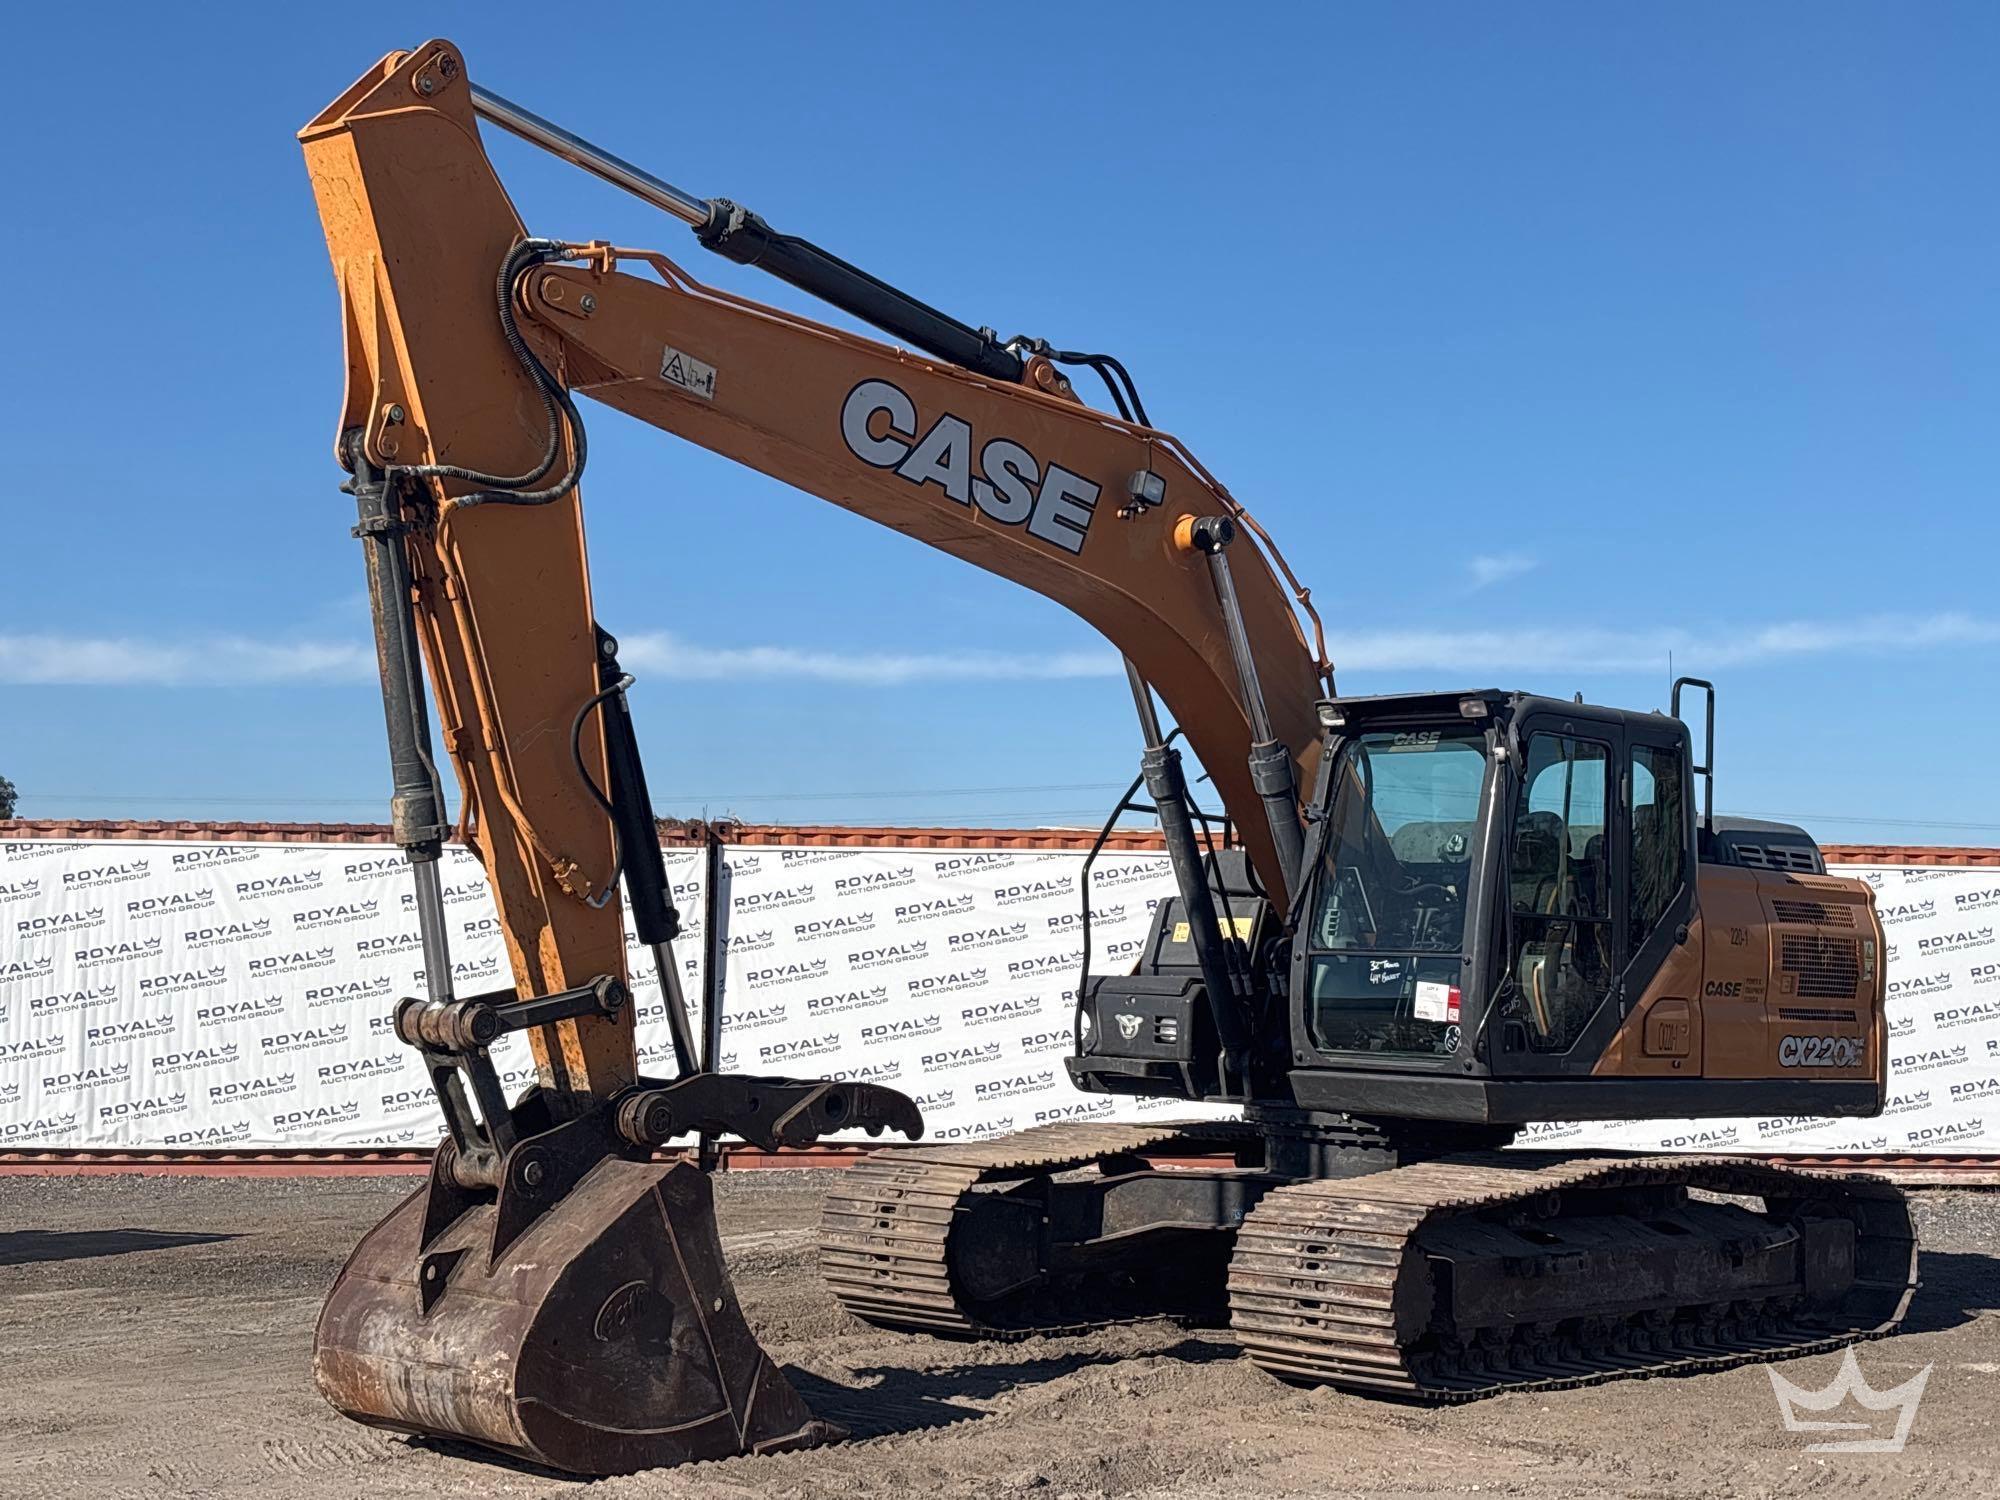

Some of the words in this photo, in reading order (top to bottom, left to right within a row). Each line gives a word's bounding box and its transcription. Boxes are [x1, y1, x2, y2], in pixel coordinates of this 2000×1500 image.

[840, 377, 1102, 555] CASE
[1393, 731, 1441, 745] CASE
[172, 846, 239, 865] ROYAL
[175, 860, 221, 873] AUCTION
[223, 854, 259, 864] GROUP
[784, 857, 826, 868] AUCTION
[935, 854, 996, 871] ROYAL
[63, 865, 131, 883] ROYAL
[938, 867, 979, 878] AUCTION
[981, 861, 1015, 871] GROUP
[1094, 863, 1154, 881] ROYAL
[1905, 872, 1946, 883] AUCTION
[65, 879, 112, 891] AUCTION
[114, 872, 151, 883] GROUP
[237, 875, 303, 893] ROYAL
[835, 872, 897, 889] ROYAL
[838, 885, 880, 896] AUCTION
[882, 879, 915, 889] GROUP
[1096, 877, 1137, 888] AUCTION
[1140, 870, 1172, 881] GROUP
[4, 891, 40, 902] GROUP
[239, 889, 285, 901] AUCTION
[287, 882, 323, 893] GROUP
[734, 890, 797, 907] ROYAL
[994, 881, 1056, 899] ROYAL
[997, 895, 1039, 906] AUCTION
[1041, 888, 1075, 898] GROUP
[127, 893, 195, 912] ROYAL
[130, 907, 176, 920] AUCTION
[179, 901, 215, 912] GROUP
[737, 903, 779, 914] AUCTION
[782, 897, 815, 907] GROUP
[895, 899, 957, 916] ROYAL
[1958, 900, 1998, 912] AUCTION
[18, 912, 86, 931] ROYAL
[294, 904, 360, 923] ROYAL
[297, 919, 342, 931] AUCTION
[344, 912, 380, 923] GROUP
[898, 912, 940, 924] AUCTION
[942, 906, 975, 916] GROUP
[1905, 911, 1937, 922] GROUP
[20, 926, 67, 939] AUCTION
[69, 920, 105, 930] GROUP
[185, 923, 252, 942] ROYAL
[795, 917, 857, 934] ROYAL
[797, 930, 840, 942] AUCTION
[842, 924, 875, 934] GROUP
[187, 937, 233, 950] AUCTION
[236, 931, 272, 941] GROUP
[948, 927, 1010, 945] ROYAL
[951, 941, 993, 952] AUCTION
[995, 935, 1029, 945] GROUP
[1918, 931, 1978, 949] ROYAL
[76, 942, 143, 961] ROYAL
[848, 945, 910, 963] ROYAL
[1921, 945, 1962, 956] AUCTION
[1964, 939, 1995, 948] GROUP
[78, 956, 124, 969] AUCTION
[127, 950, 163, 960] GROUP
[249, 951, 316, 970] ROYAL
[252, 966, 297, 978] AUCTION
[300, 959, 336, 970] GROUP
[851, 959, 893, 970] AUCTION
[895, 953, 929, 963] GROUP
[1007, 954, 1070, 972] ROYAL
[17, 969, 53, 980] GROUP
[140, 971, 208, 989] ROYAL
[747, 964, 810, 981] ROYAL
[749, 977, 792, 989] AUCTION
[794, 971, 828, 981] GROUP
[908, 972, 970, 990] ROYAL
[1010, 968, 1053, 980] AUCTION
[142, 985, 189, 997] AUCTION
[191, 978, 227, 989] GROUP
[306, 981, 372, 1000] ROYAL
[911, 986, 953, 998] AUCTION
[955, 980, 989, 990] GROUP
[1705, 980, 1742, 997] CASE
[1919, 985, 1952, 996] GROUP
[31, 990, 98, 1009] ROYAL
[309, 995, 354, 1007] AUCTION
[356, 989, 392, 999] GROUP
[807, 991, 870, 1009] ROYAL
[810, 1005, 853, 1016] AUCTION
[855, 998, 888, 1008] GROUP
[33, 1004, 79, 1017] AUCTION
[82, 998, 118, 1008] GROUP
[197, 1000, 265, 1019] ROYAL
[961, 1000, 1024, 1019] ROYAL
[1934, 1004, 1993, 1022] ROYAL
[200, 1014, 246, 1027] AUCTION
[248, 1008, 284, 1019] GROUP
[964, 1015, 1007, 1027] AUCTION
[1009, 1008, 1042, 1018] GROUP
[1936, 1018, 1977, 1029] AUCTION
[88, 1020, 156, 1039] ROYAL
[90, 1034, 137, 1047] AUCTION
[139, 1028, 175, 1038] GROUP
[861, 1019, 924, 1038] ROYAL
[864, 1033, 907, 1045] AUCTION
[909, 1027, 942, 1037] GROUP
[261, 1029, 328, 1047] ROYAL
[264, 1043, 310, 1055] AUCTION
[312, 1036, 348, 1047] GROUP
[759, 1038, 823, 1056] ROYAL
[29, 1047, 65, 1058] GROUP
[152, 1048, 220, 1067] ROYAL
[762, 1052, 805, 1064] AUCTION
[807, 1046, 842, 1056] GROUP
[921, 1046, 984, 1065] ROYAL
[1891, 1050, 1951, 1068] ROYAL
[155, 1062, 201, 1075] AUCTION
[203, 1056, 240, 1067] GROUP
[318, 1058, 385, 1077] ROYAL
[924, 1061, 967, 1073] AUCTION
[969, 1054, 1002, 1064] GROUP
[1894, 1064, 1935, 1075] AUCTION
[1937, 1058, 1968, 1067] GROUP
[43, 1068, 110, 1087] ROYAL
[321, 1072, 366, 1085] AUCTION
[369, 1066, 405, 1076] GROUP
[975, 1075, 1037, 1094] ROYAL
[45, 1082, 92, 1095] AUCTION
[94, 1076, 130, 1086] GROUP
[209, 1078, 277, 1097] ROYAL
[977, 1089, 1020, 1101] AUCTION
[1023, 1083, 1056, 1093] GROUP
[212, 1092, 258, 1105] AUCTION
[260, 1086, 297, 1096] GROUP
[1953, 1091, 1993, 1103] AUCTION
[100, 1098, 168, 1117] ROYAL
[102, 1112, 149, 1125] AUCTION
[151, 1106, 188, 1116] GROUP
[273, 1106, 341, 1125] ROYAL
[1035, 1102, 1098, 1121] ROYAL
[1899, 1102, 1932, 1113] GROUP
[276, 1120, 322, 1133] AUCTION
[324, 1114, 360, 1124] GROUP
[935, 1121, 997, 1140] ROYAL
[1760, 1128, 1801, 1139] AUCTION
[1803, 1122, 1835, 1131] GROUP
[1908, 1123, 1967, 1141] ROYAL
[164, 1126, 232, 1145] ROYAL
[216, 1134, 252, 1145] GROUP
[1910, 1137, 1951, 1148] AUCTION
[1953, 1131, 1985, 1140] GROUP
